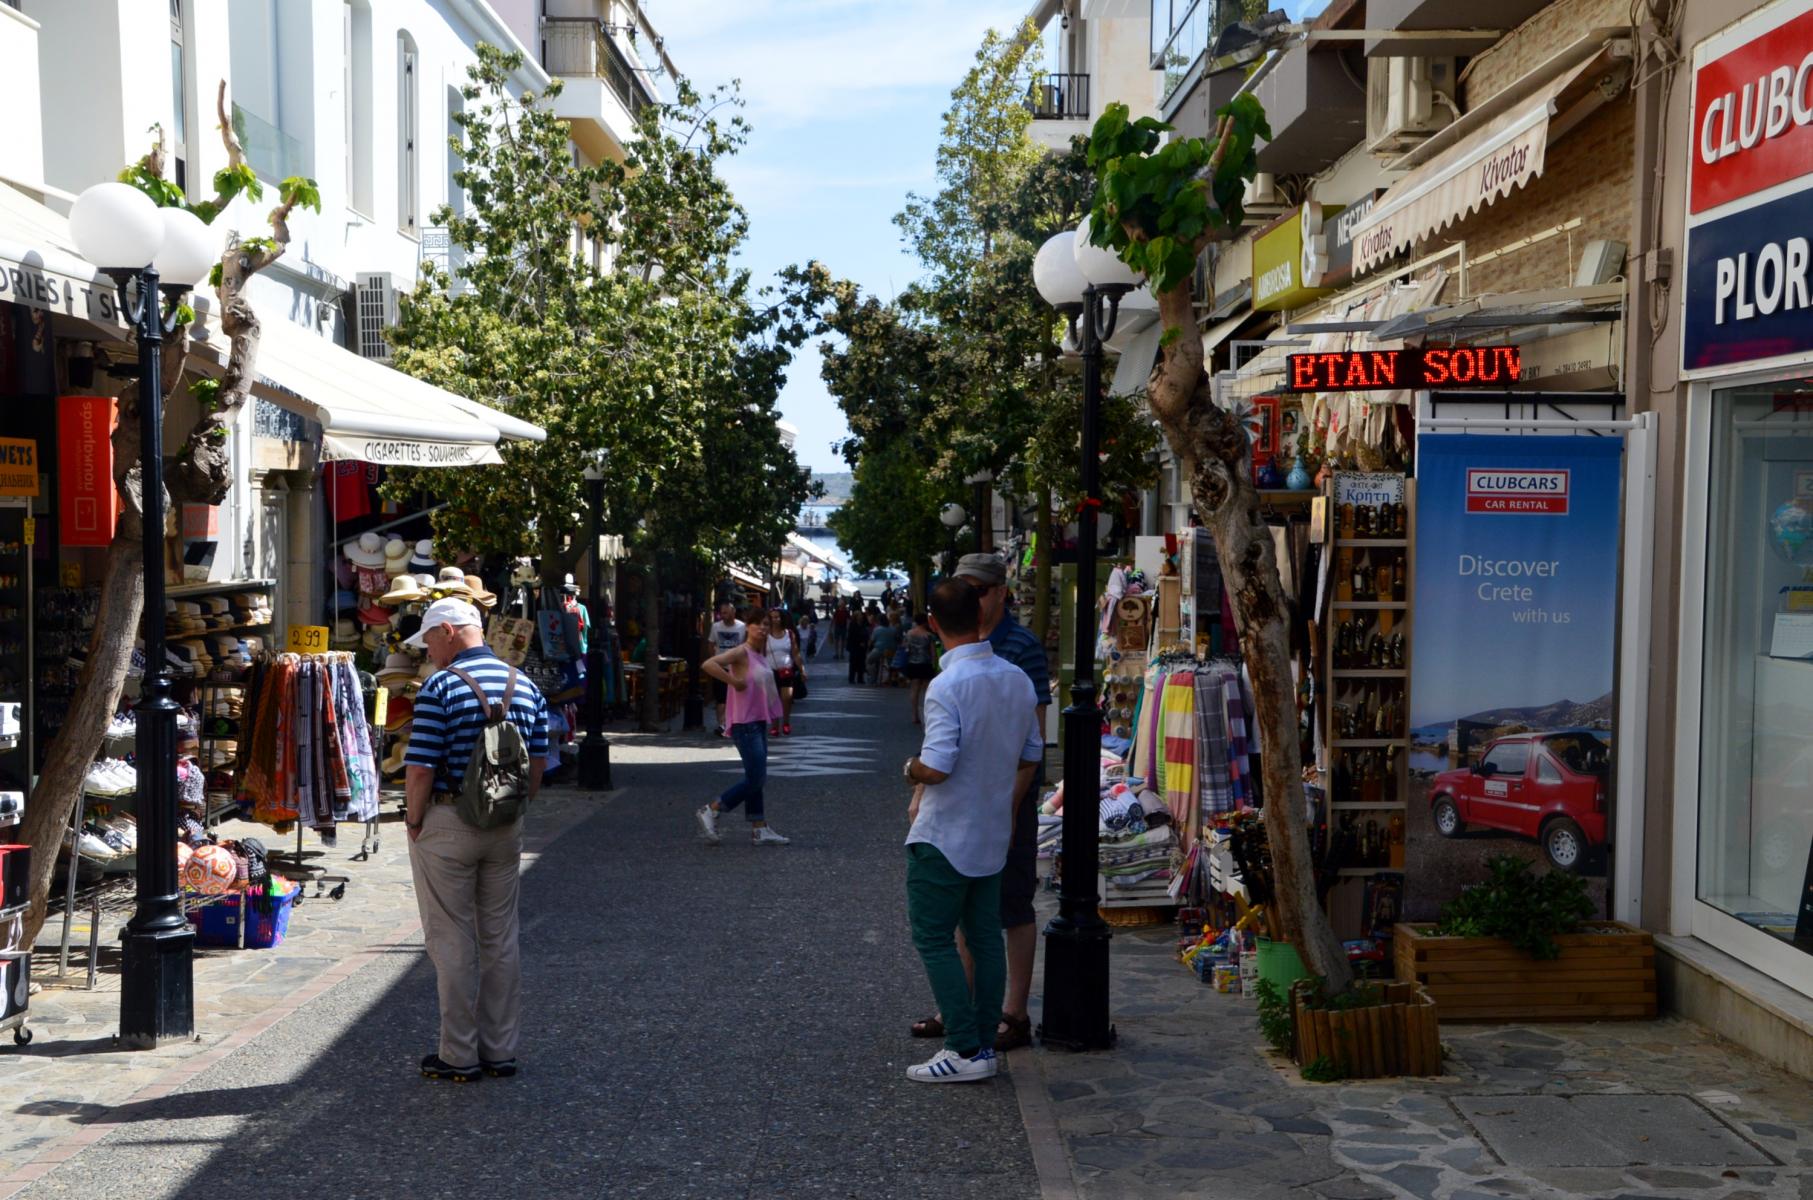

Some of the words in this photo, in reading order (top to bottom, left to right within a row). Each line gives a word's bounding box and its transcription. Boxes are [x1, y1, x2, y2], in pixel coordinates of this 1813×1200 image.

[1480, 144, 1530, 196] Kivotos
[1257, 260, 1292, 302] AMBROSIA
[1301, 200, 1325, 288] &
[1360, 226, 1393, 263] Kivotos
[1715, 236, 1813, 325] PLOR
[1293, 351, 1399, 388] ETAN
[364, 442, 421, 462] CIGARETTES
[1477, 476, 1559, 490] CLUBCARS
[1346, 488, 1390, 505] Κρήτη
[1485, 500, 1506, 509] CAR
[1509, 501, 1549, 510] RENTAL
[1459, 554, 1560, 577] Discover
[1478, 582, 1533, 601] Crete
[1512, 608, 1548, 623] with
[1552, 611, 1571, 623] us
